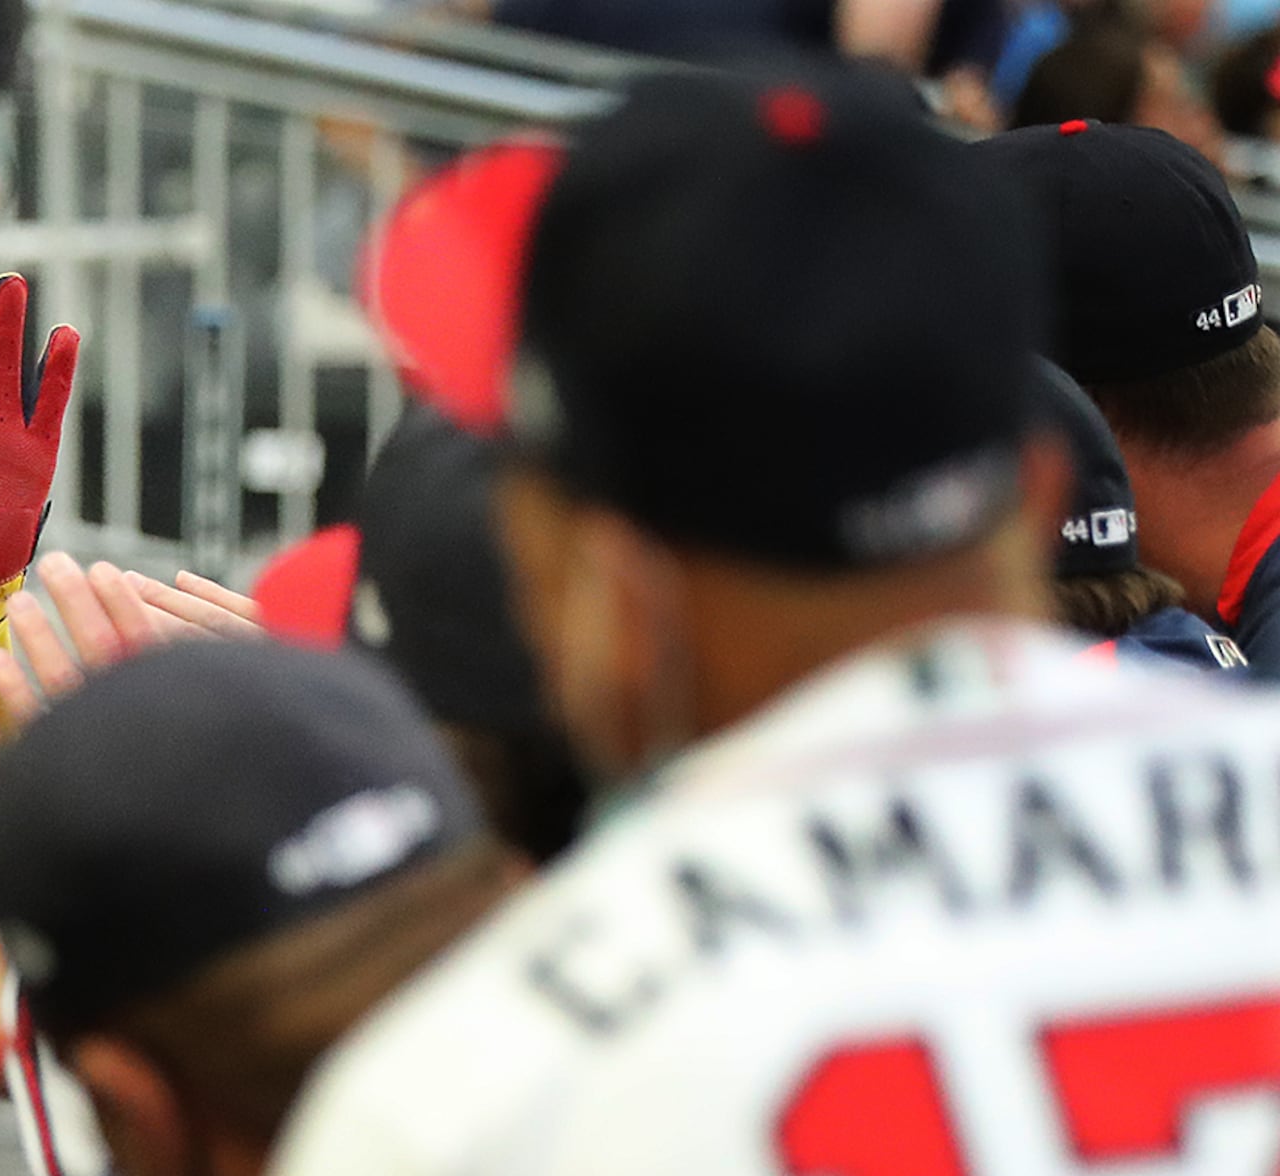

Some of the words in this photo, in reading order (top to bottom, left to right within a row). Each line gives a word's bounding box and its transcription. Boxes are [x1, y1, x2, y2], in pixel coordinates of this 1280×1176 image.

[1196, 308, 1222, 331] 44
[1061, 518, 1090, 541] 44
[526, 752, 1280, 1038] CAMAR
